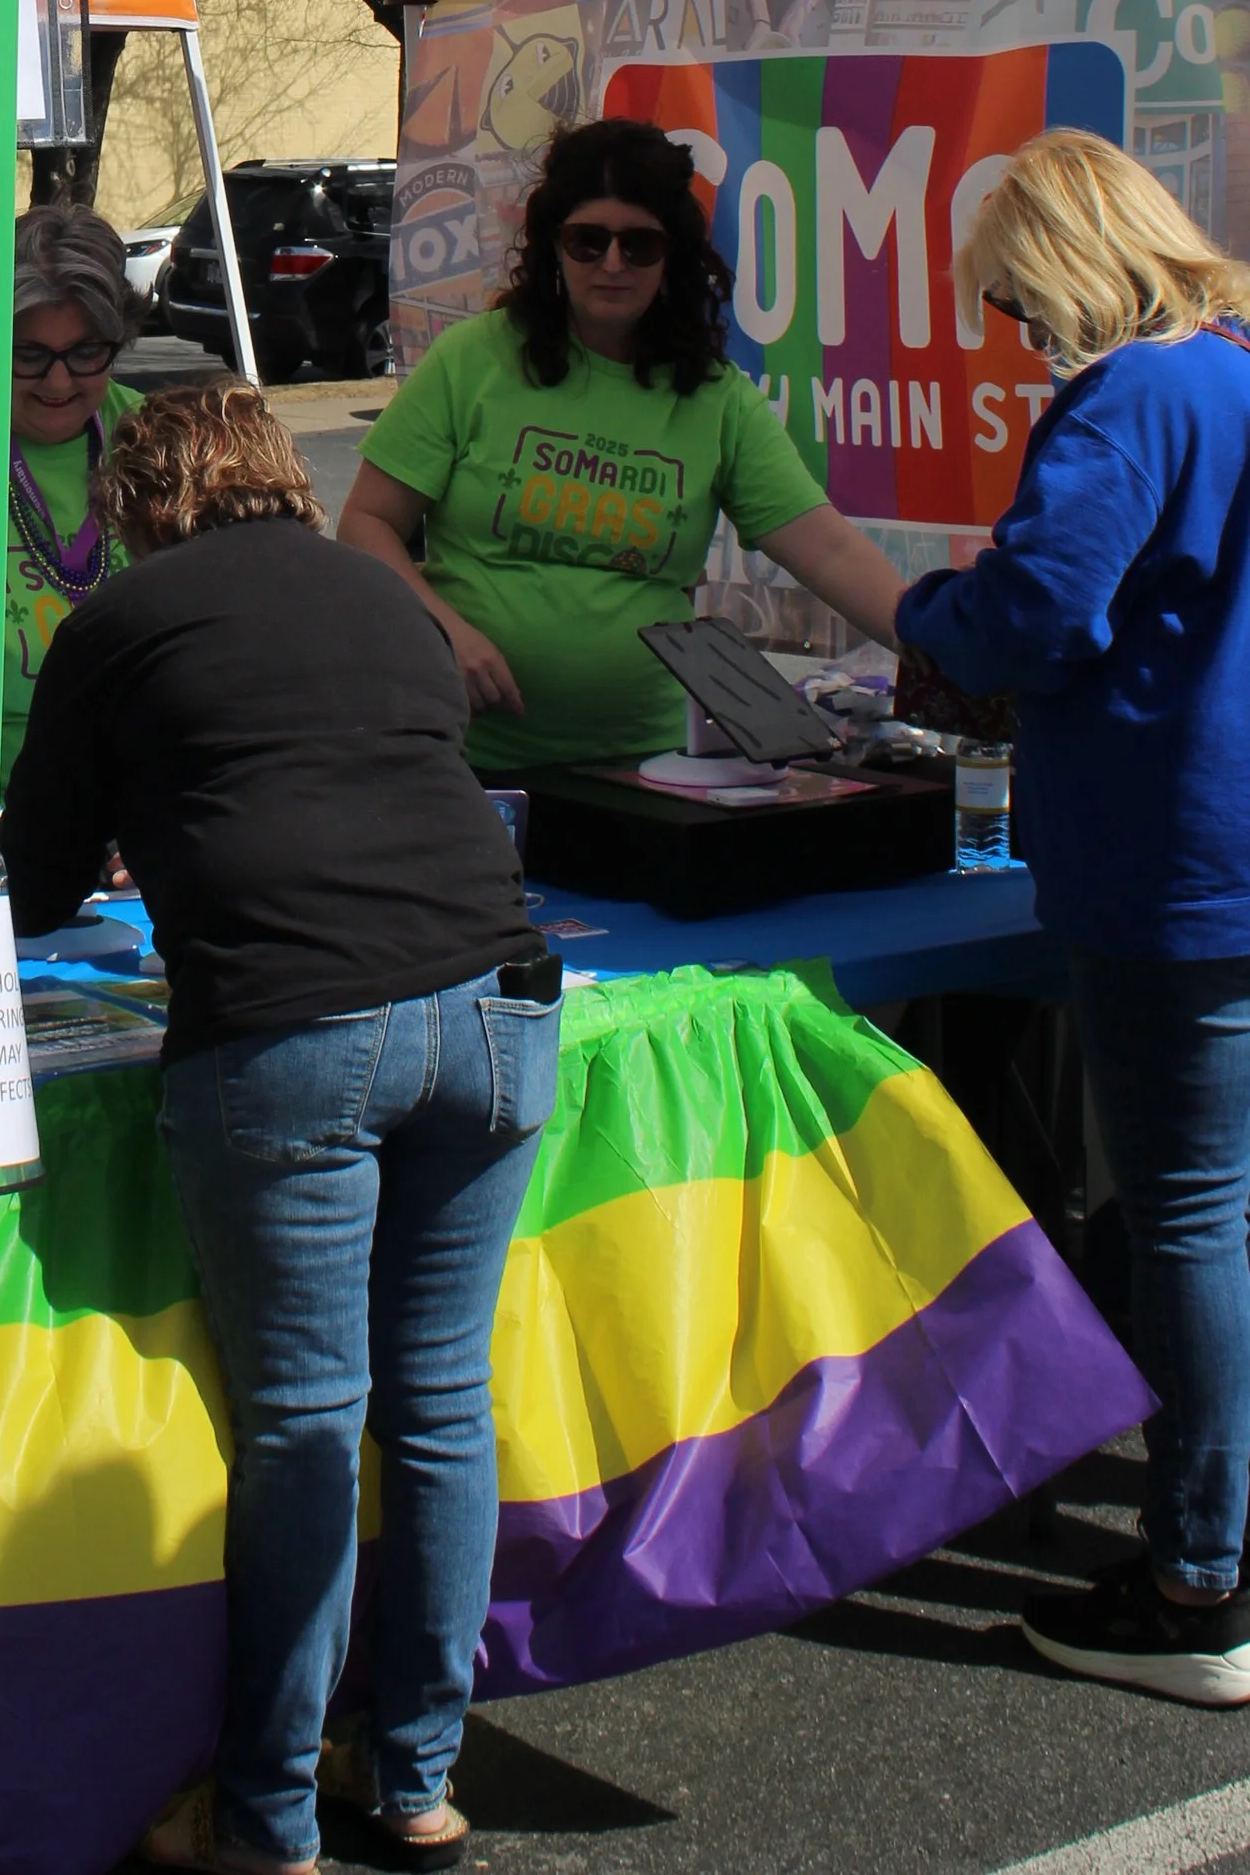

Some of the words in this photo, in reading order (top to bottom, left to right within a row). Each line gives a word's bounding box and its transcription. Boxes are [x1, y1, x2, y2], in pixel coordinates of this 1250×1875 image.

[400, 169, 469, 207] MODERN
[811, 375, 943, 450] MAIN
[585, 433, 629, 457] 2025
[519, 475, 664, 549] GRAS
